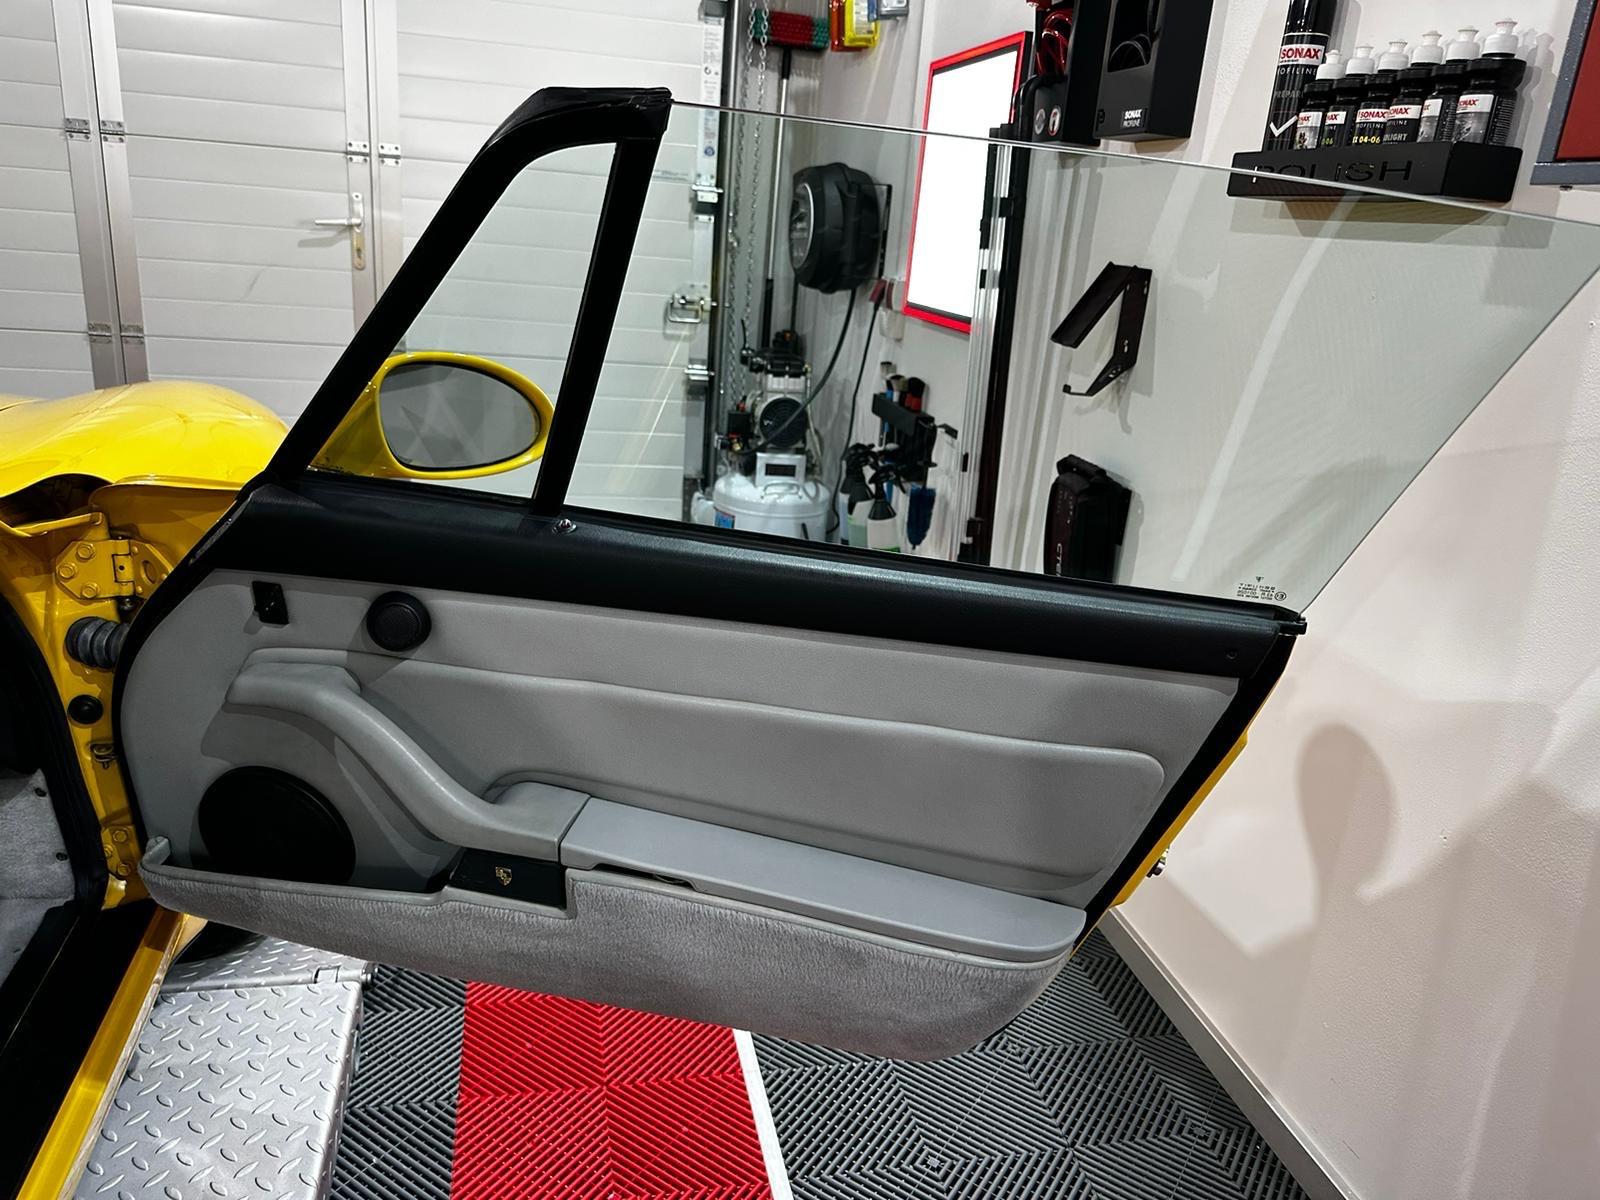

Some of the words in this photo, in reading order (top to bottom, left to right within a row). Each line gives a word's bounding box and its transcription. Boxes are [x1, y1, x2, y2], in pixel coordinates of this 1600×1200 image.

[1281, 47, 1321, 60] SONAX
[1360, 111, 1386, 119] SONAX
[1251, 160, 1413, 184] POLISH
